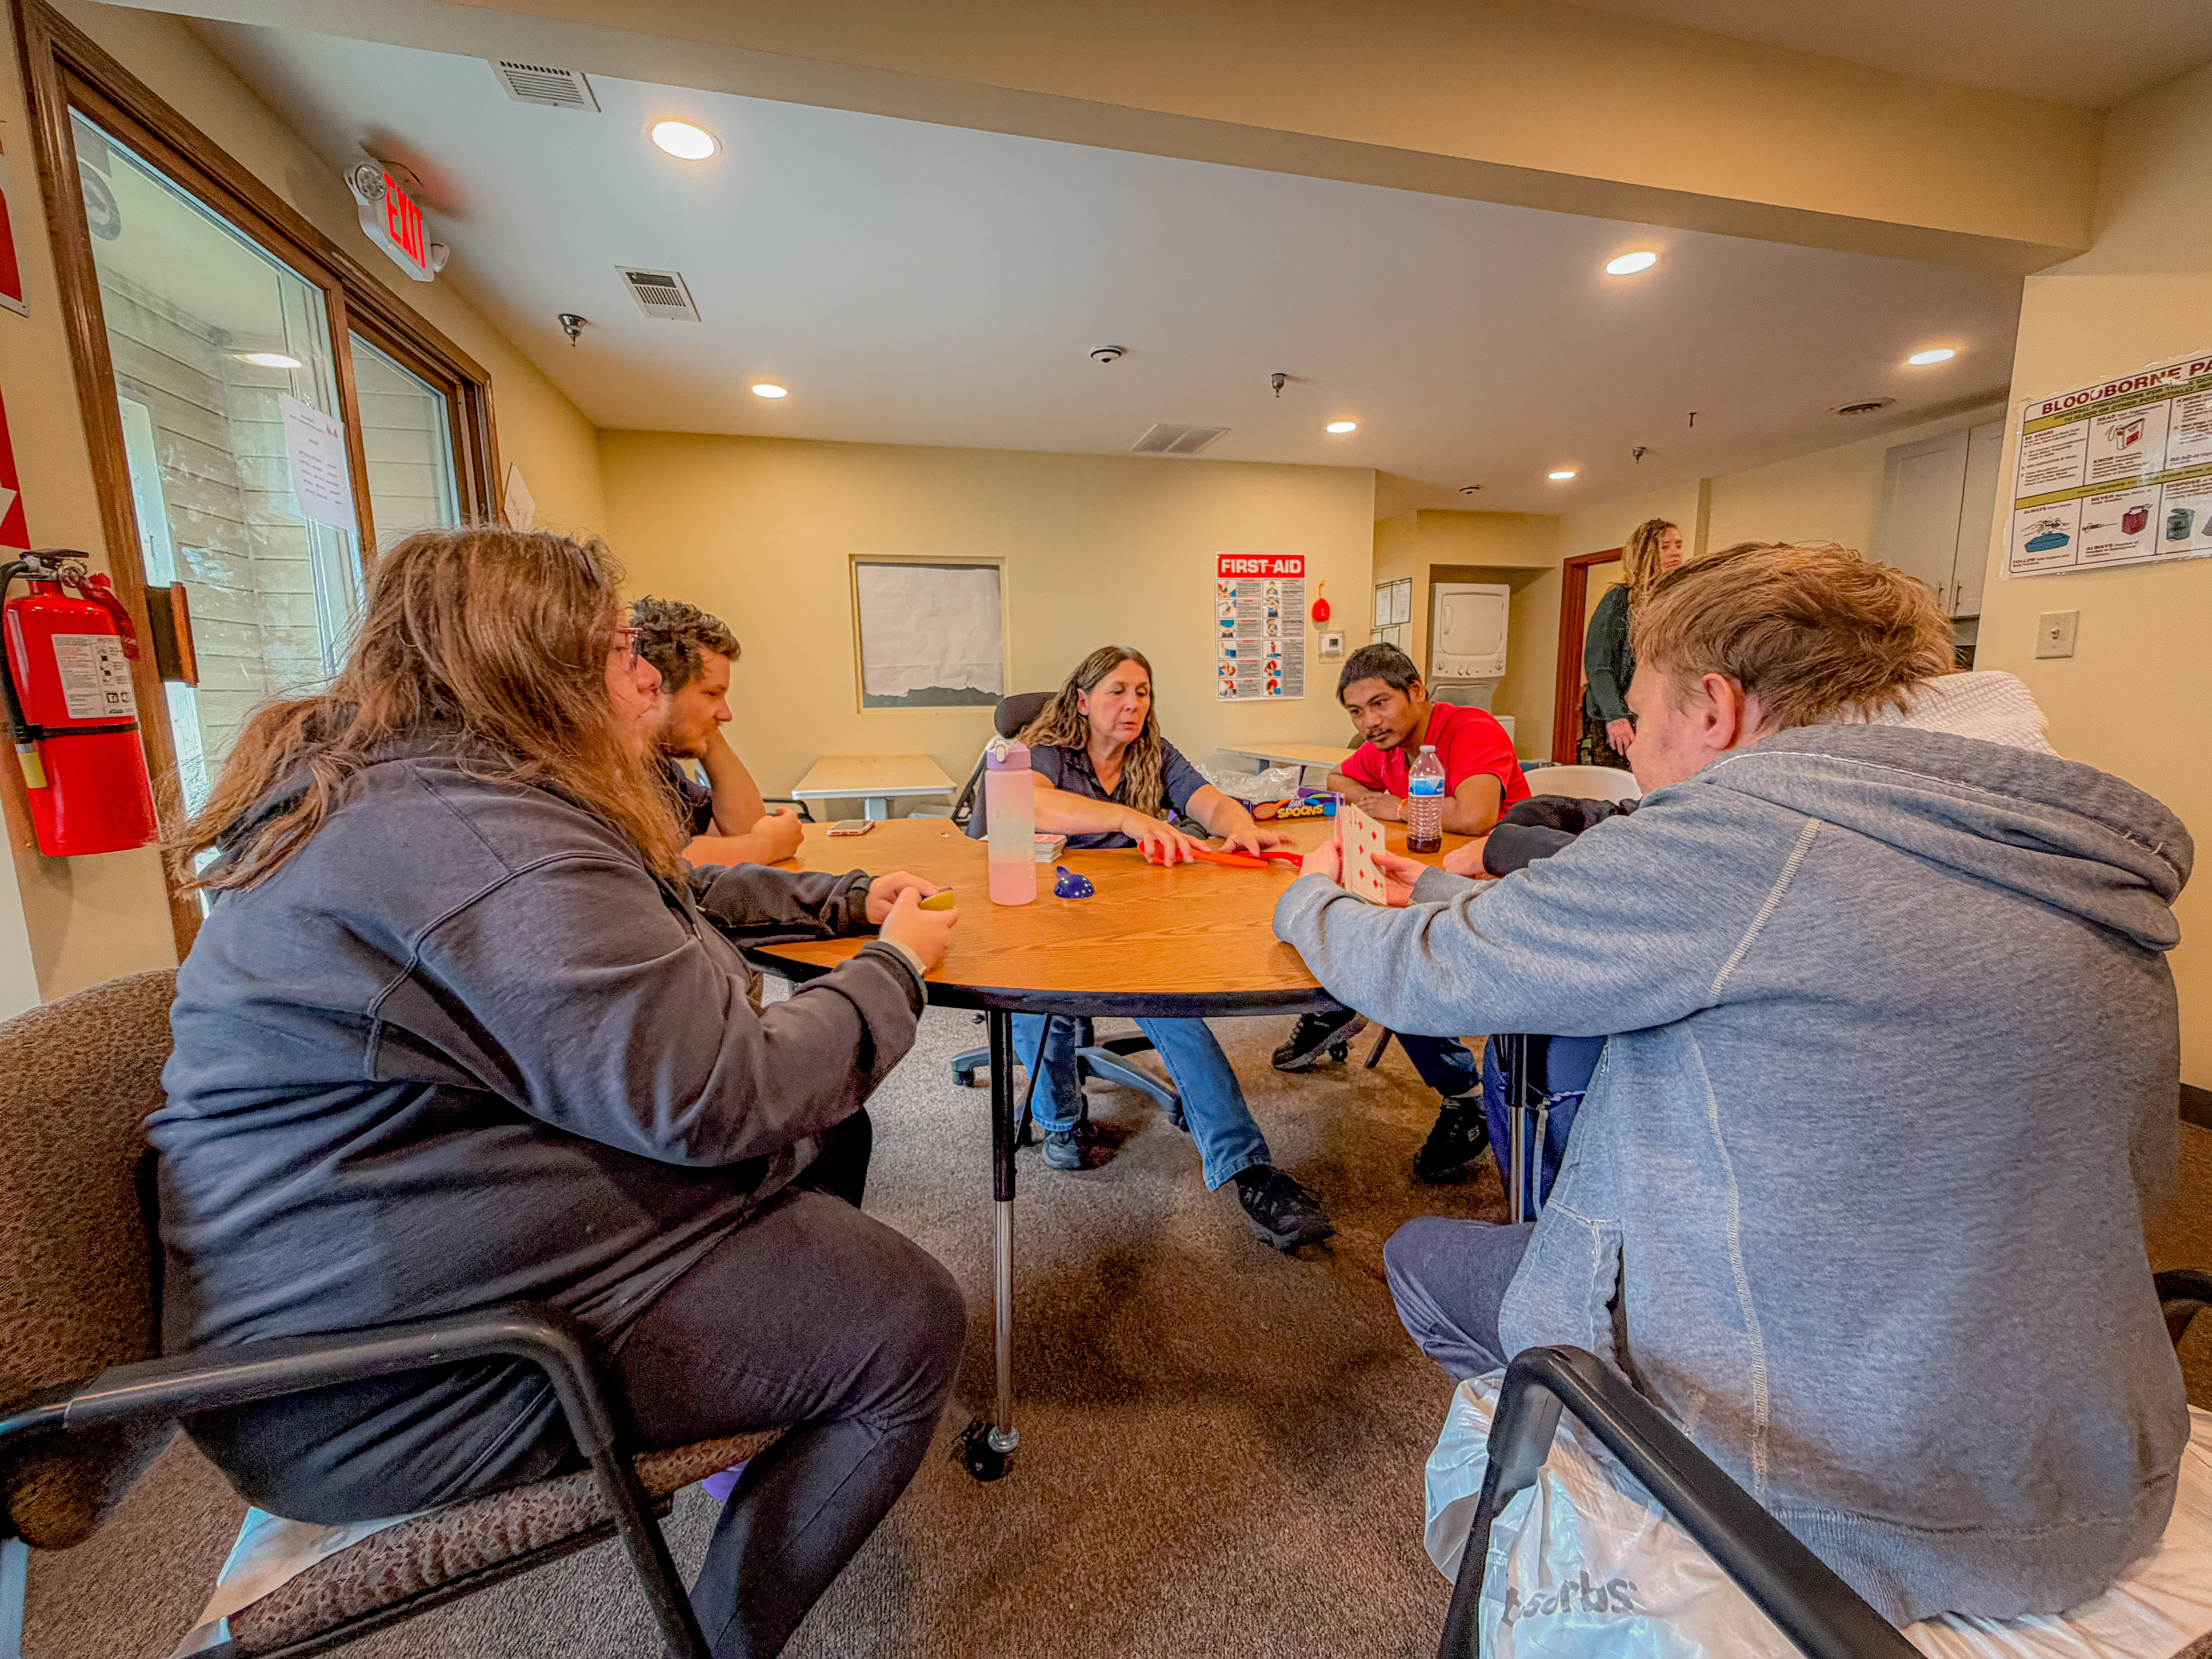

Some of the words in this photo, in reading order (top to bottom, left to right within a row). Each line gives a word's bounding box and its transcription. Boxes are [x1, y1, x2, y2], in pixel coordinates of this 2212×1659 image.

[383, 172, 426, 269] EXIT
[2042, 367, 2181, 415] BLOODBORNE
[1221, 559, 1269, 573] FIRST
[1273, 559, 1302, 574] AID
[1277, 804, 1324, 818] SPOONS
